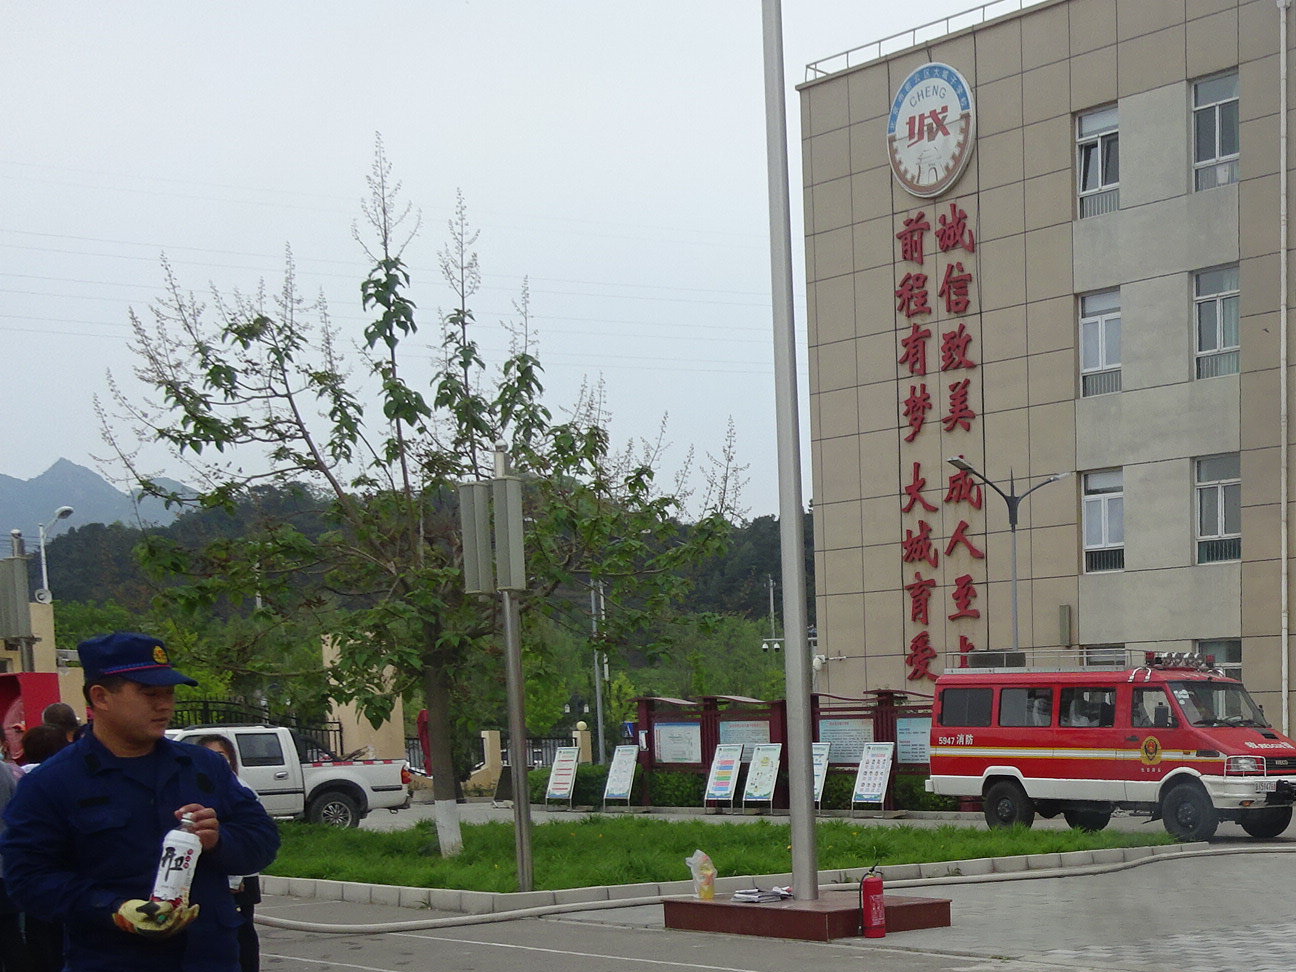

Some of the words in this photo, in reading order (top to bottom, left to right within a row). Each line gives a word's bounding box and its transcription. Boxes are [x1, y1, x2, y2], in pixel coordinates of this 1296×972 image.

[909, 85, 947, 107] CHENG
[896, 211, 932, 442] 前程有梦
[935, 203, 977, 432] 诚信致美
[938, 736, 955, 745] 5947
[956, 733, 973, 745] 消防
